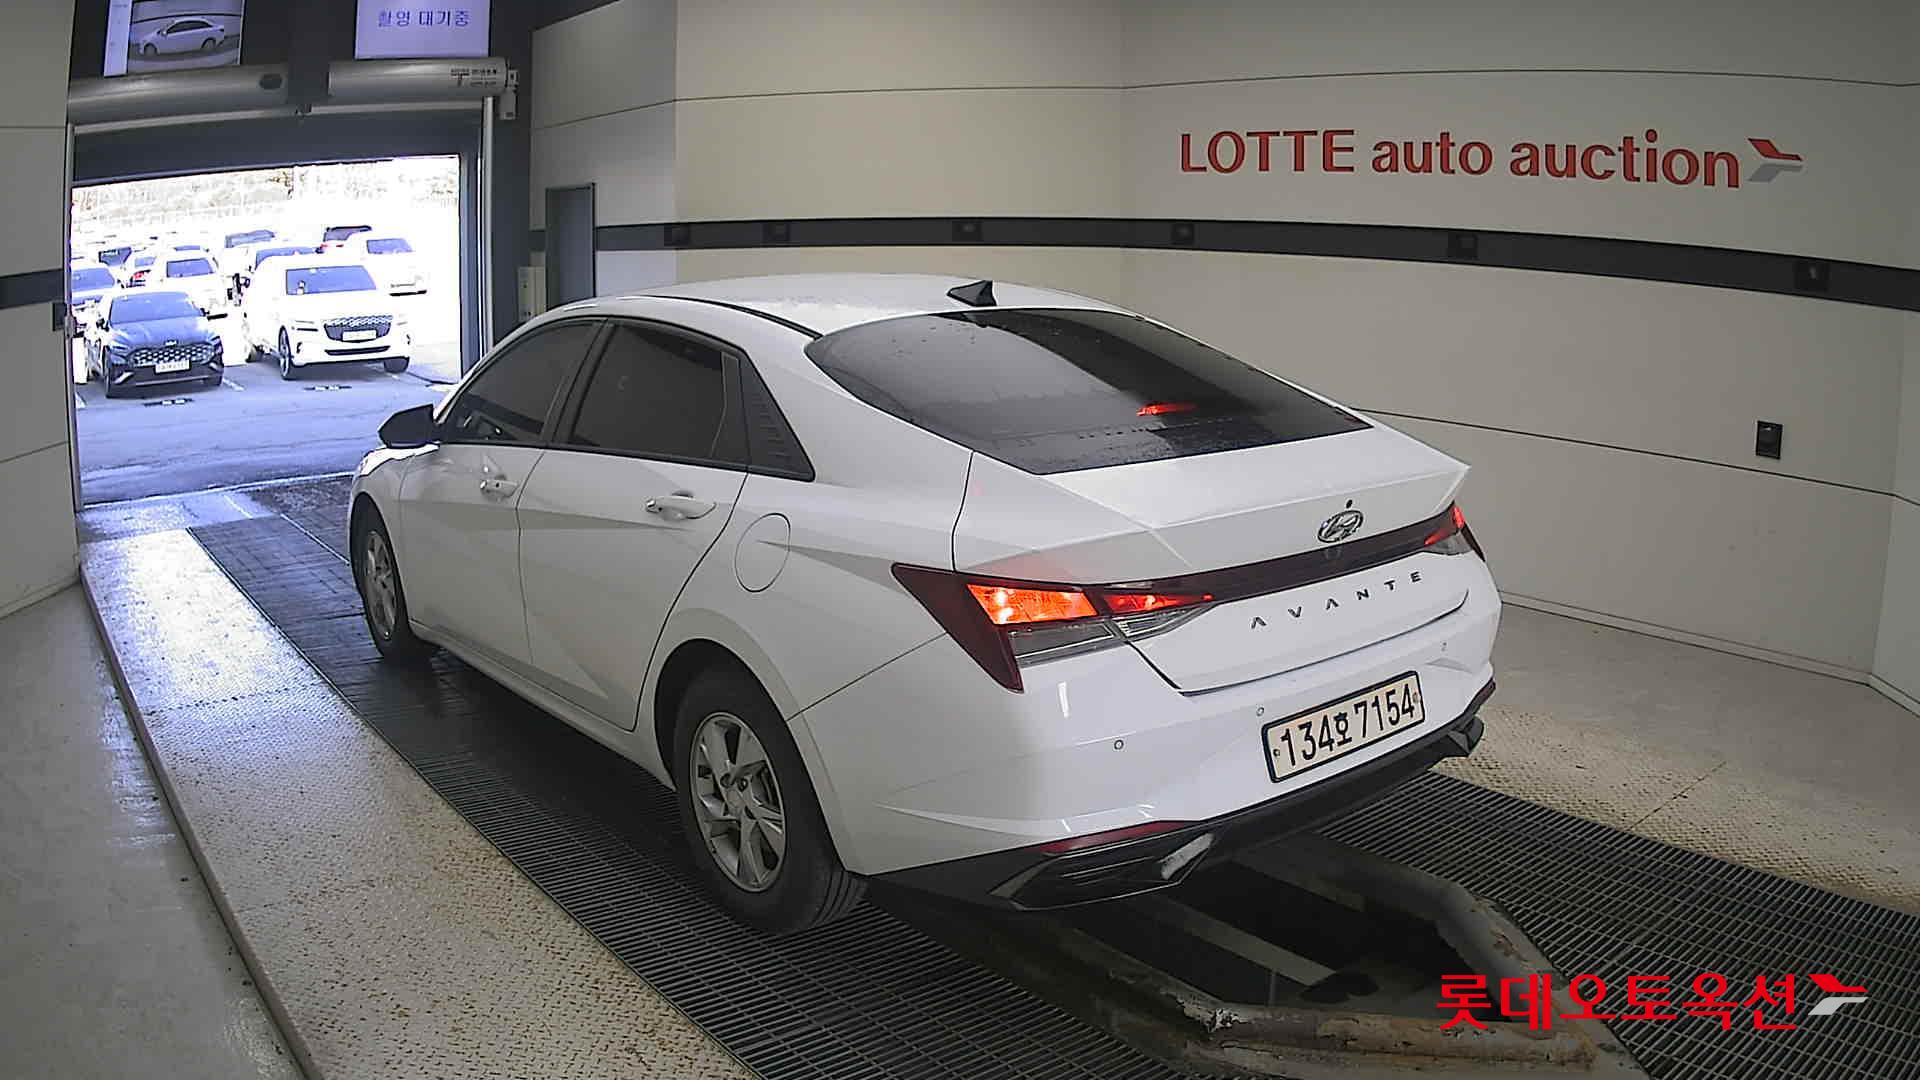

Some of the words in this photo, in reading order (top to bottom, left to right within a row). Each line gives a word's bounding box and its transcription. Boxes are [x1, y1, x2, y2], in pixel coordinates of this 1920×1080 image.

[419, 10, 469, 27] 대기중
[1180, 129, 1355, 173] LOTTE
[1372, 131, 1494, 175] auto
[1510, 129, 1741, 188] auction
[1250, 571, 1422, 629] AVANTE
